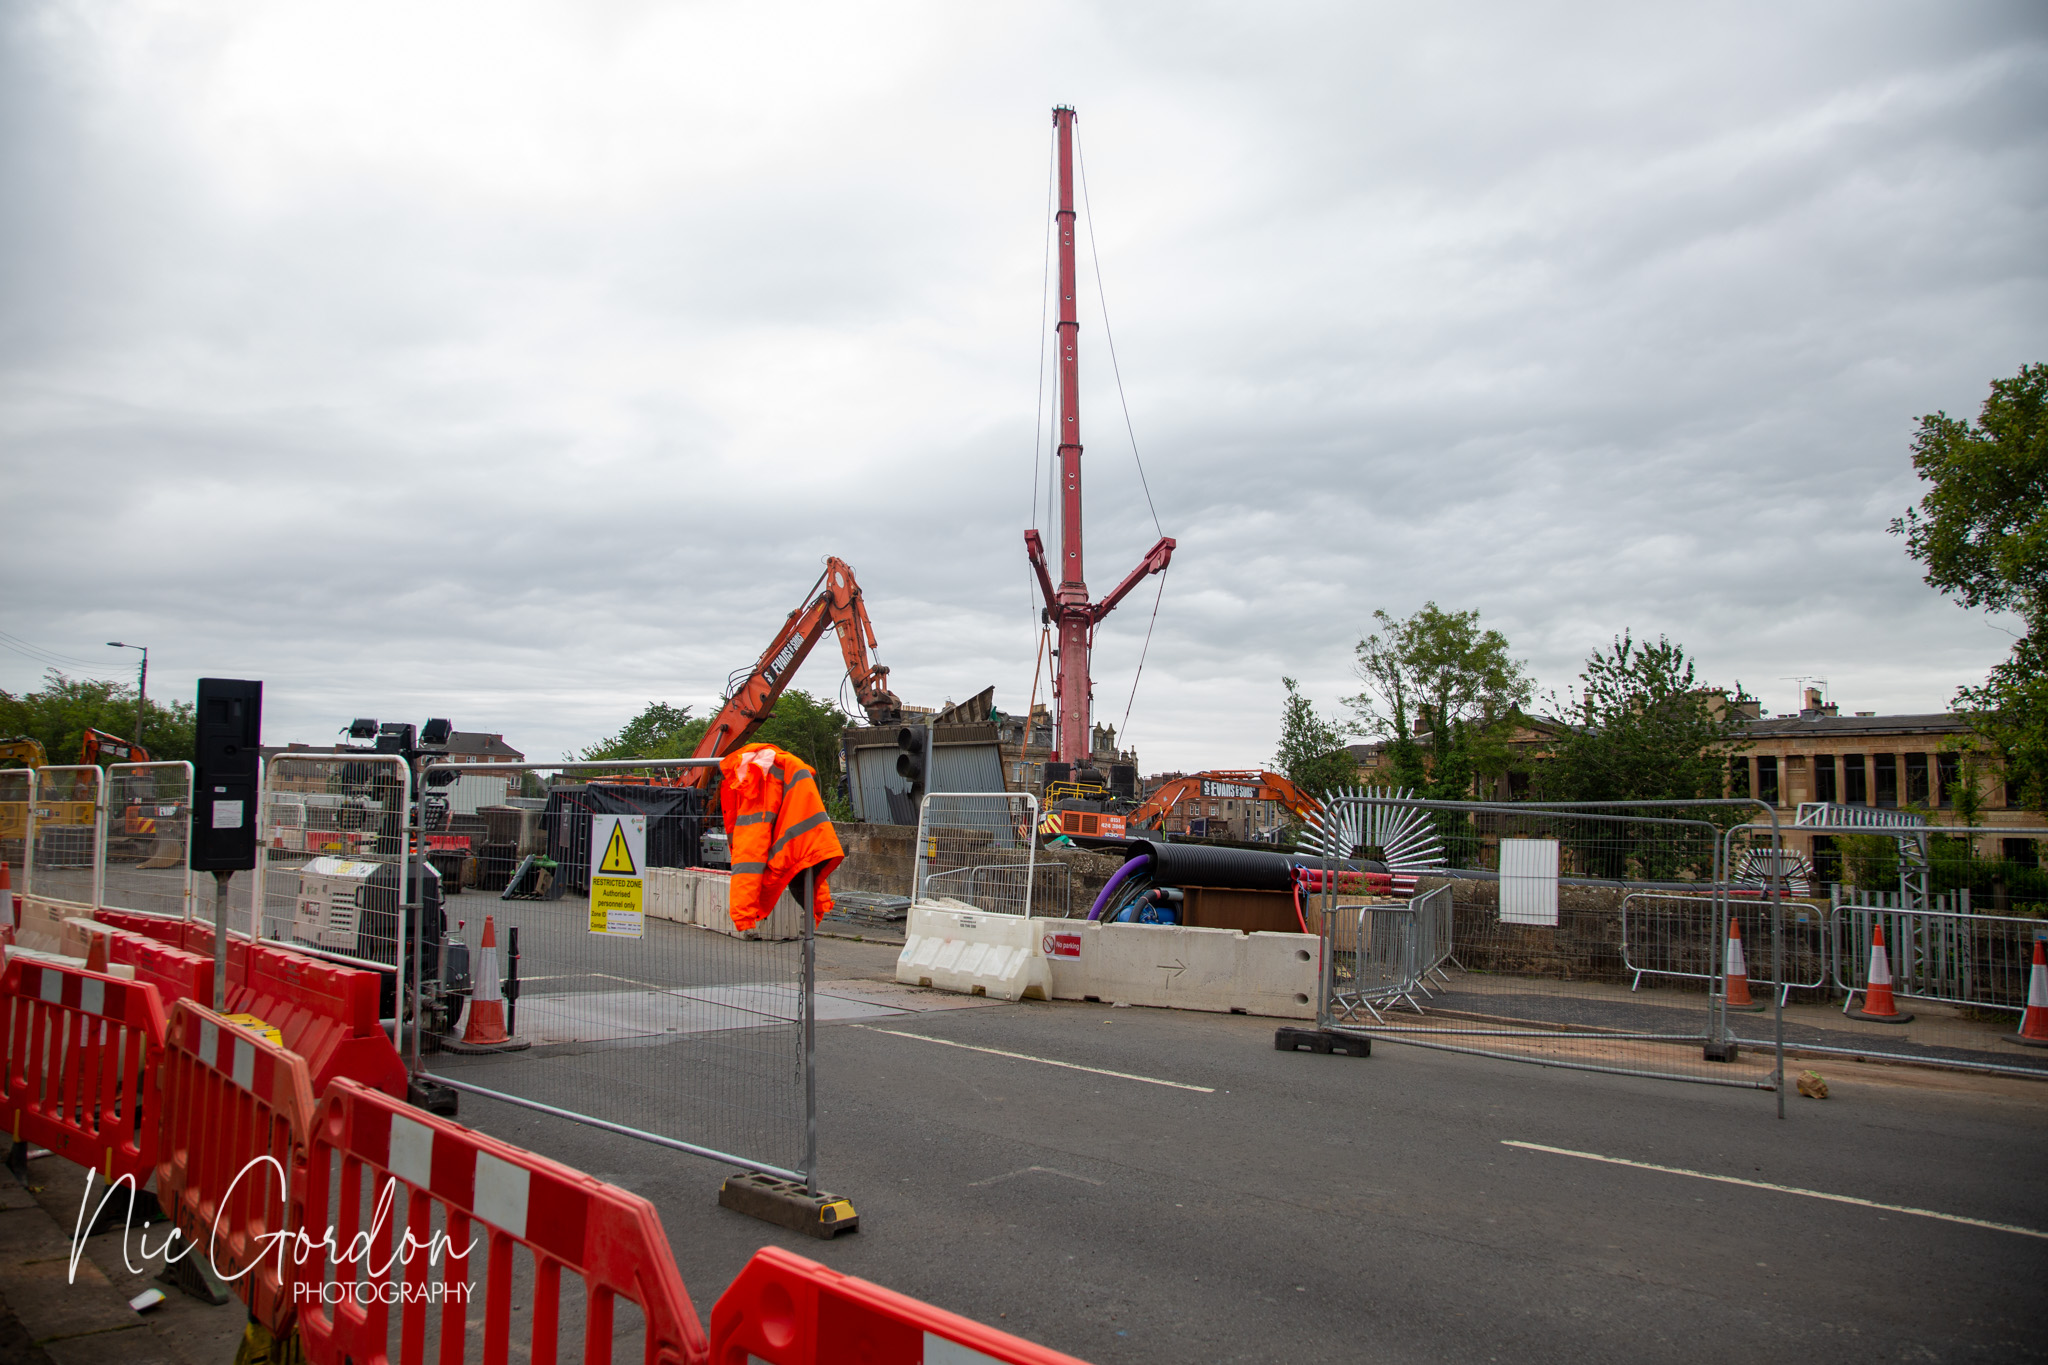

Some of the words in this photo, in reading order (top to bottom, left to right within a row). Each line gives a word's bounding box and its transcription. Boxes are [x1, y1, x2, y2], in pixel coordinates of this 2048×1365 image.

[1211, 782, 1235, 798] EVANS
[593, 878, 626, 888] RESTRICTED
[627, 880, 642, 889] ZONE
[603, 889, 630, 898] Authorised
[598, 900, 623, 908] personnel
[624, 902, 636, 910] only
[1063, 942, 1079, 951] parking
